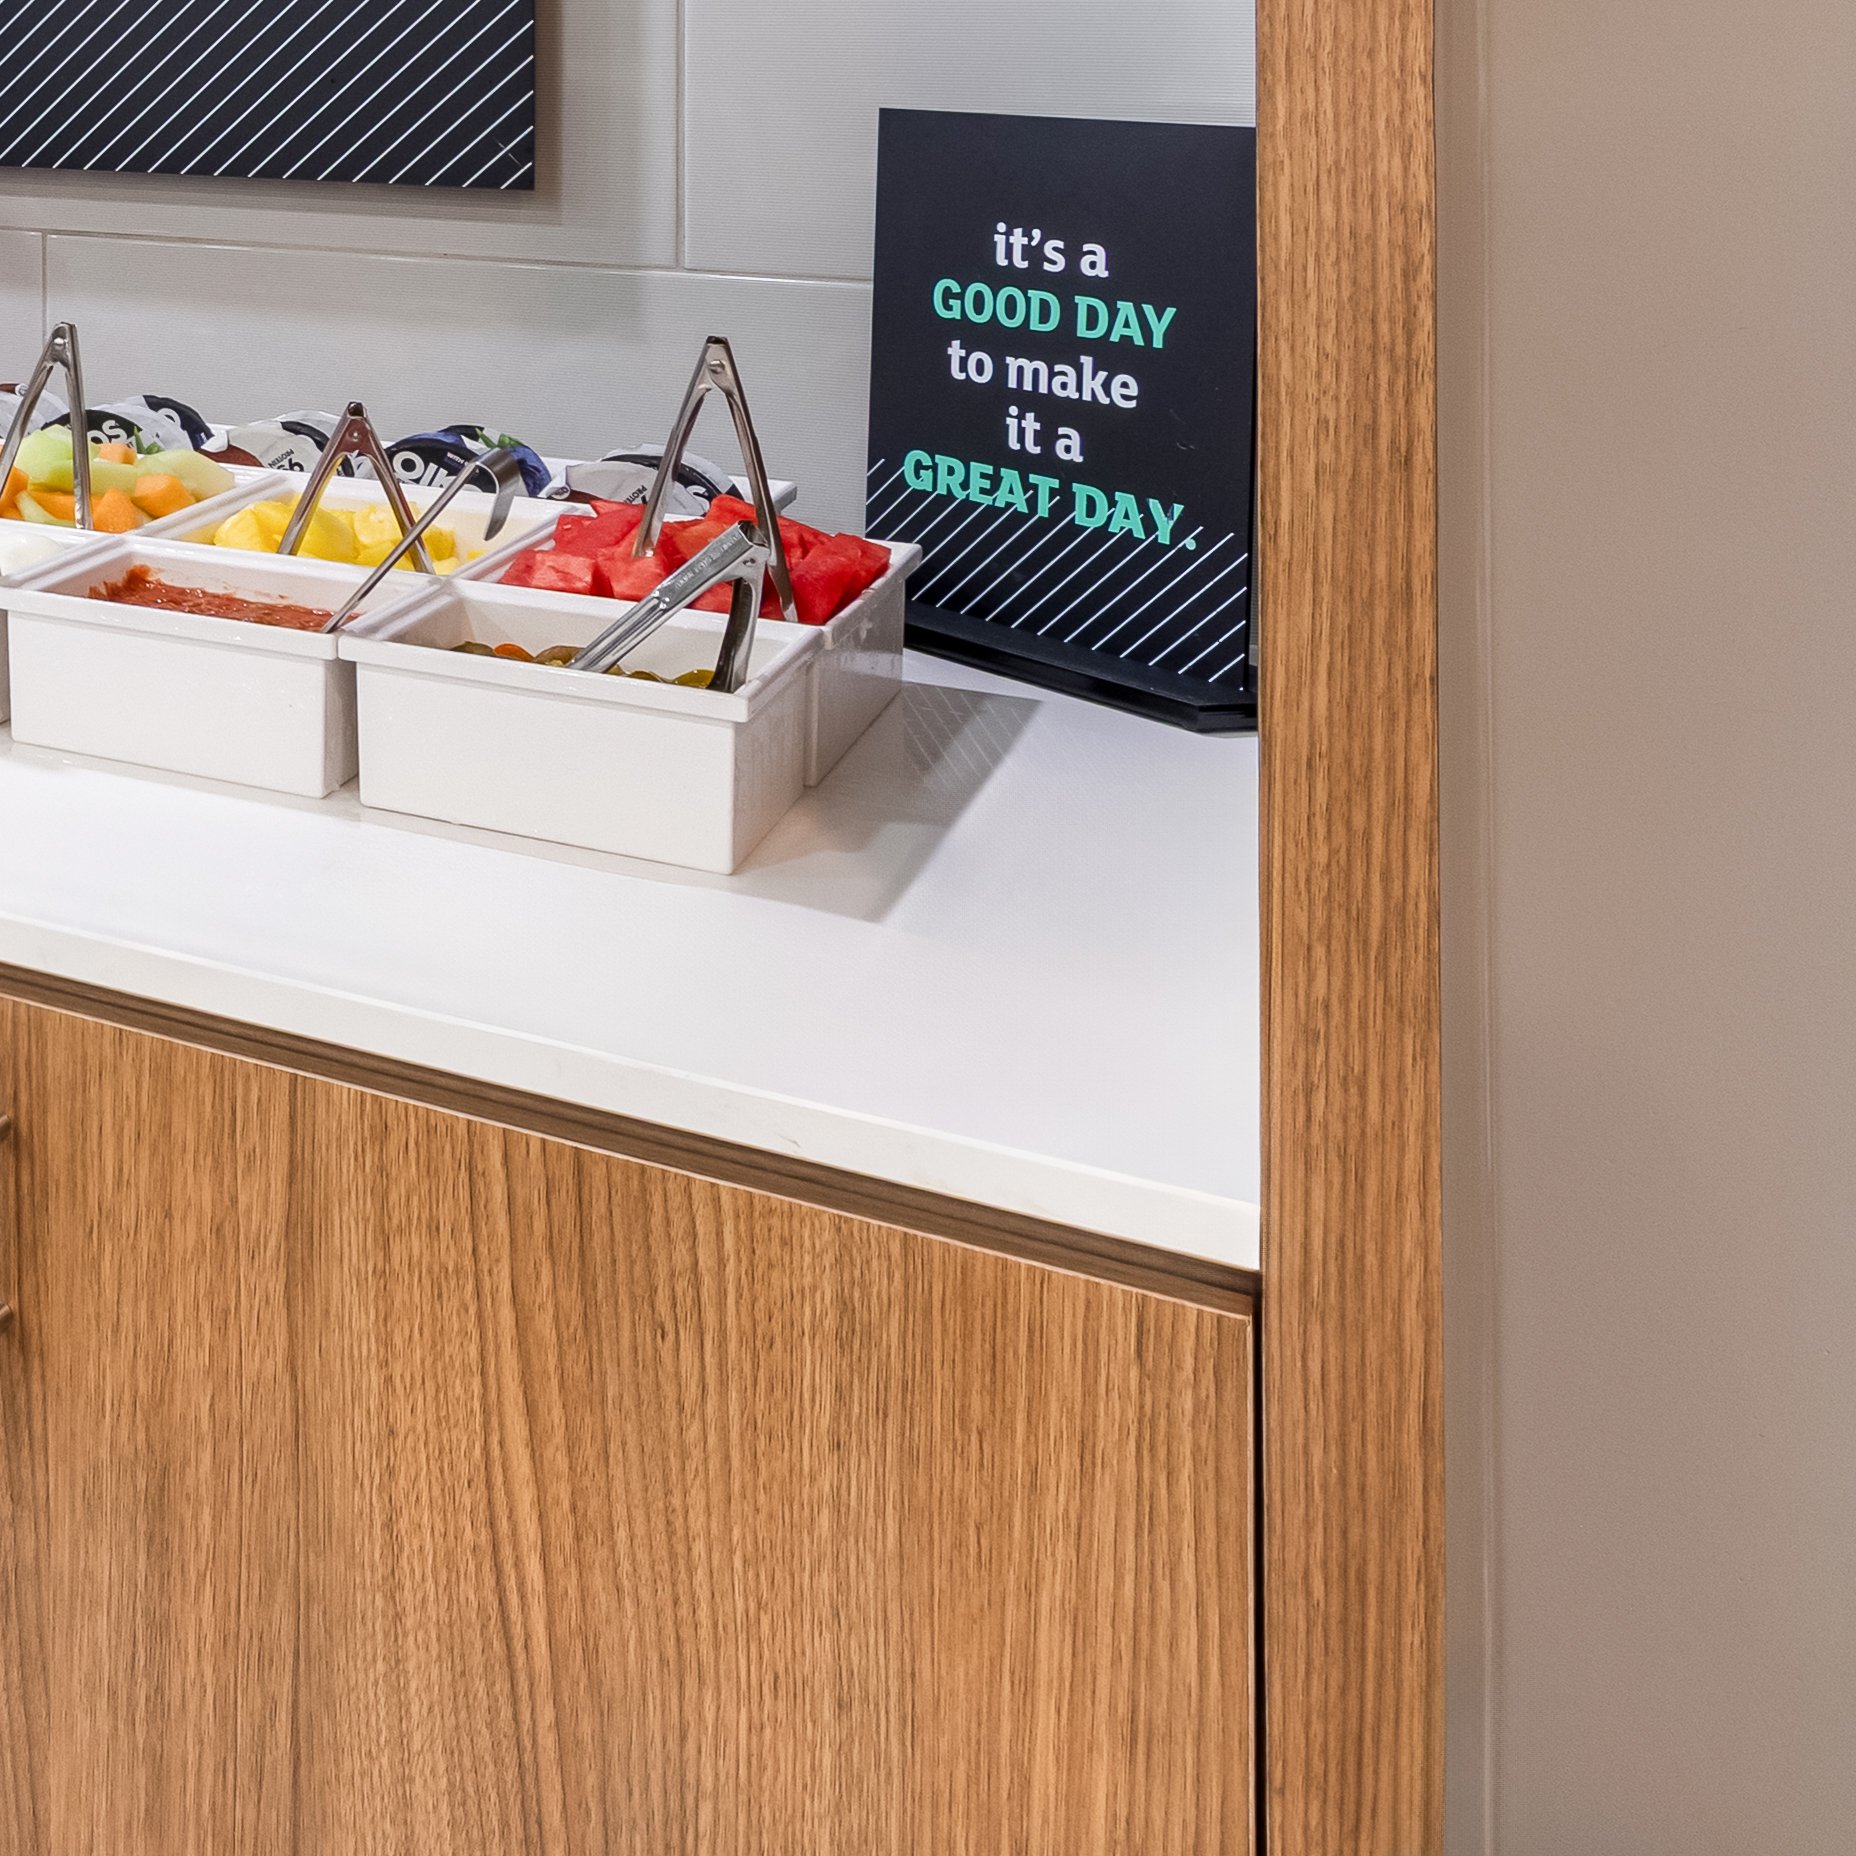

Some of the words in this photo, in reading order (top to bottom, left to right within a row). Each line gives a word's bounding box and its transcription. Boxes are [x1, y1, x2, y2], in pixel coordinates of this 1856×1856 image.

[993, 222, 1066, 273] it's
[1080, 241, 1109, 279] a
[932, 278, 1061, 333] GOOD
[1074, 295, 1177, 349] DAY
[947, 339, 994, 384] to
[1005, 354, 1139, 410] make
[1005, 405, 1041, 455] it
[1054, 424, 1084, 463] a
[902, 449, 1061, 518] GREAT
[1072, 483, 1197, 551] DAY.
